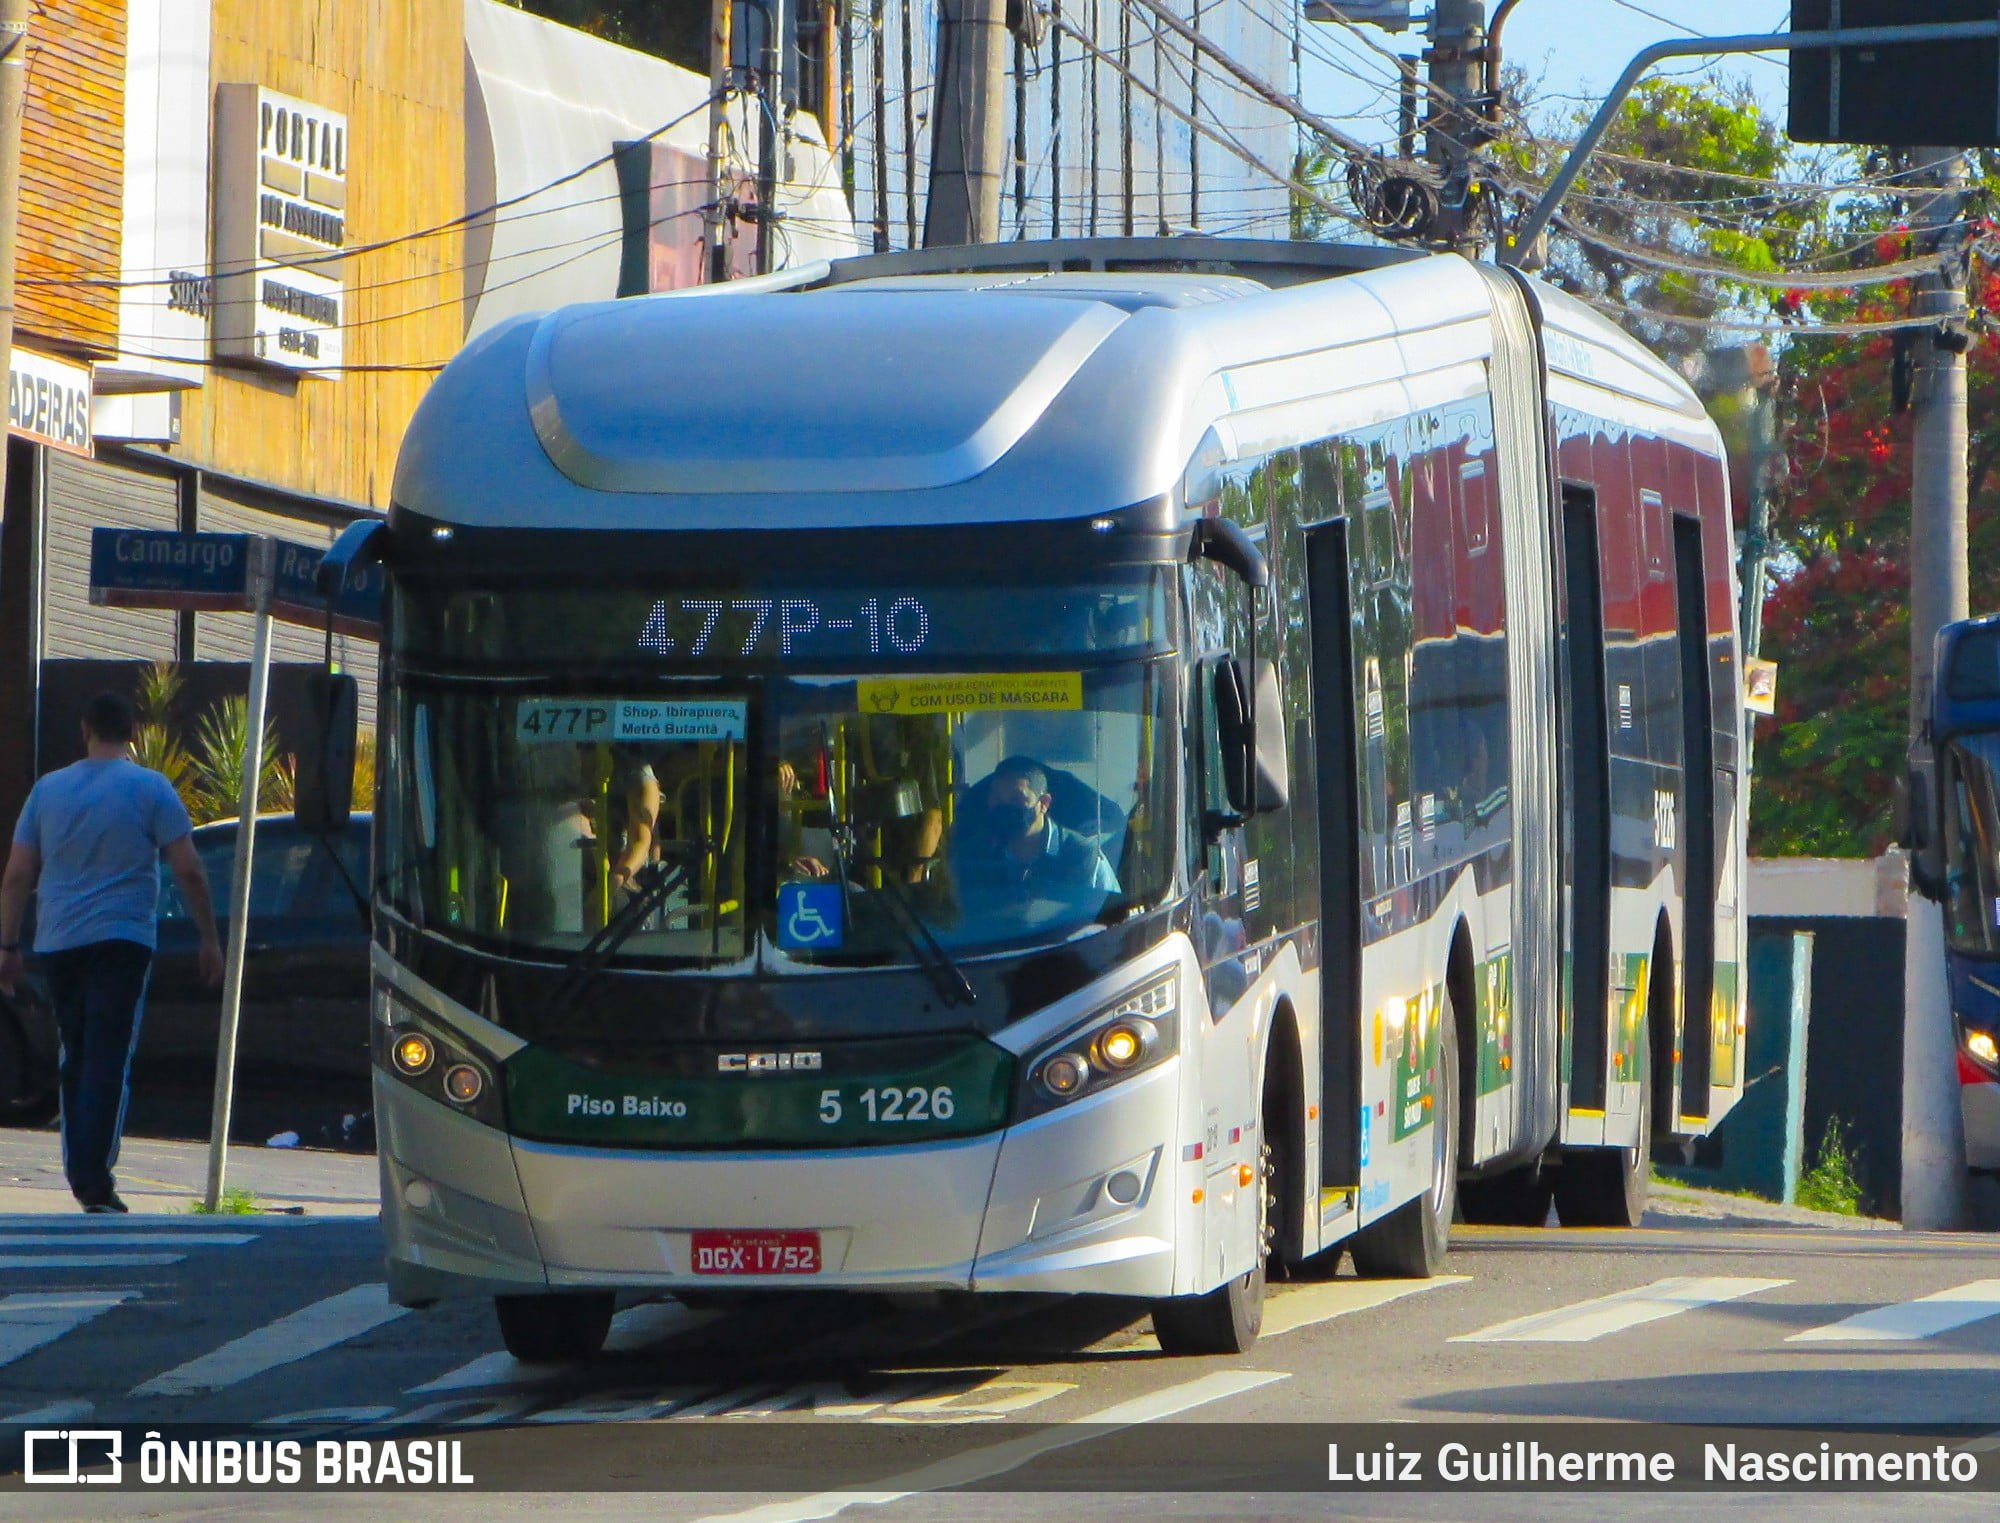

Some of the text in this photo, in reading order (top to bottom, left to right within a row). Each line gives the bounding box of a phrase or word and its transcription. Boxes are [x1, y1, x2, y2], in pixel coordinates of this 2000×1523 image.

[261, 102, 345, 176] PORTAL
[115, 534, 233, 573] Camargo
[638, 597, 929, 655] 477P-10
[623, 706, 662, 719] Shop.
[910, 695, 942, 707] COM
[945, 694, 975, 705] USO
[979, 693, 998, 704] DE
[523, 708, 608, 734] 477P
[622, 723, 718, 735] Metrô Butantã
[567, 1094, 686, 1118] Piso Baixo
[819, 1086, 954, 1124] 5 1226
